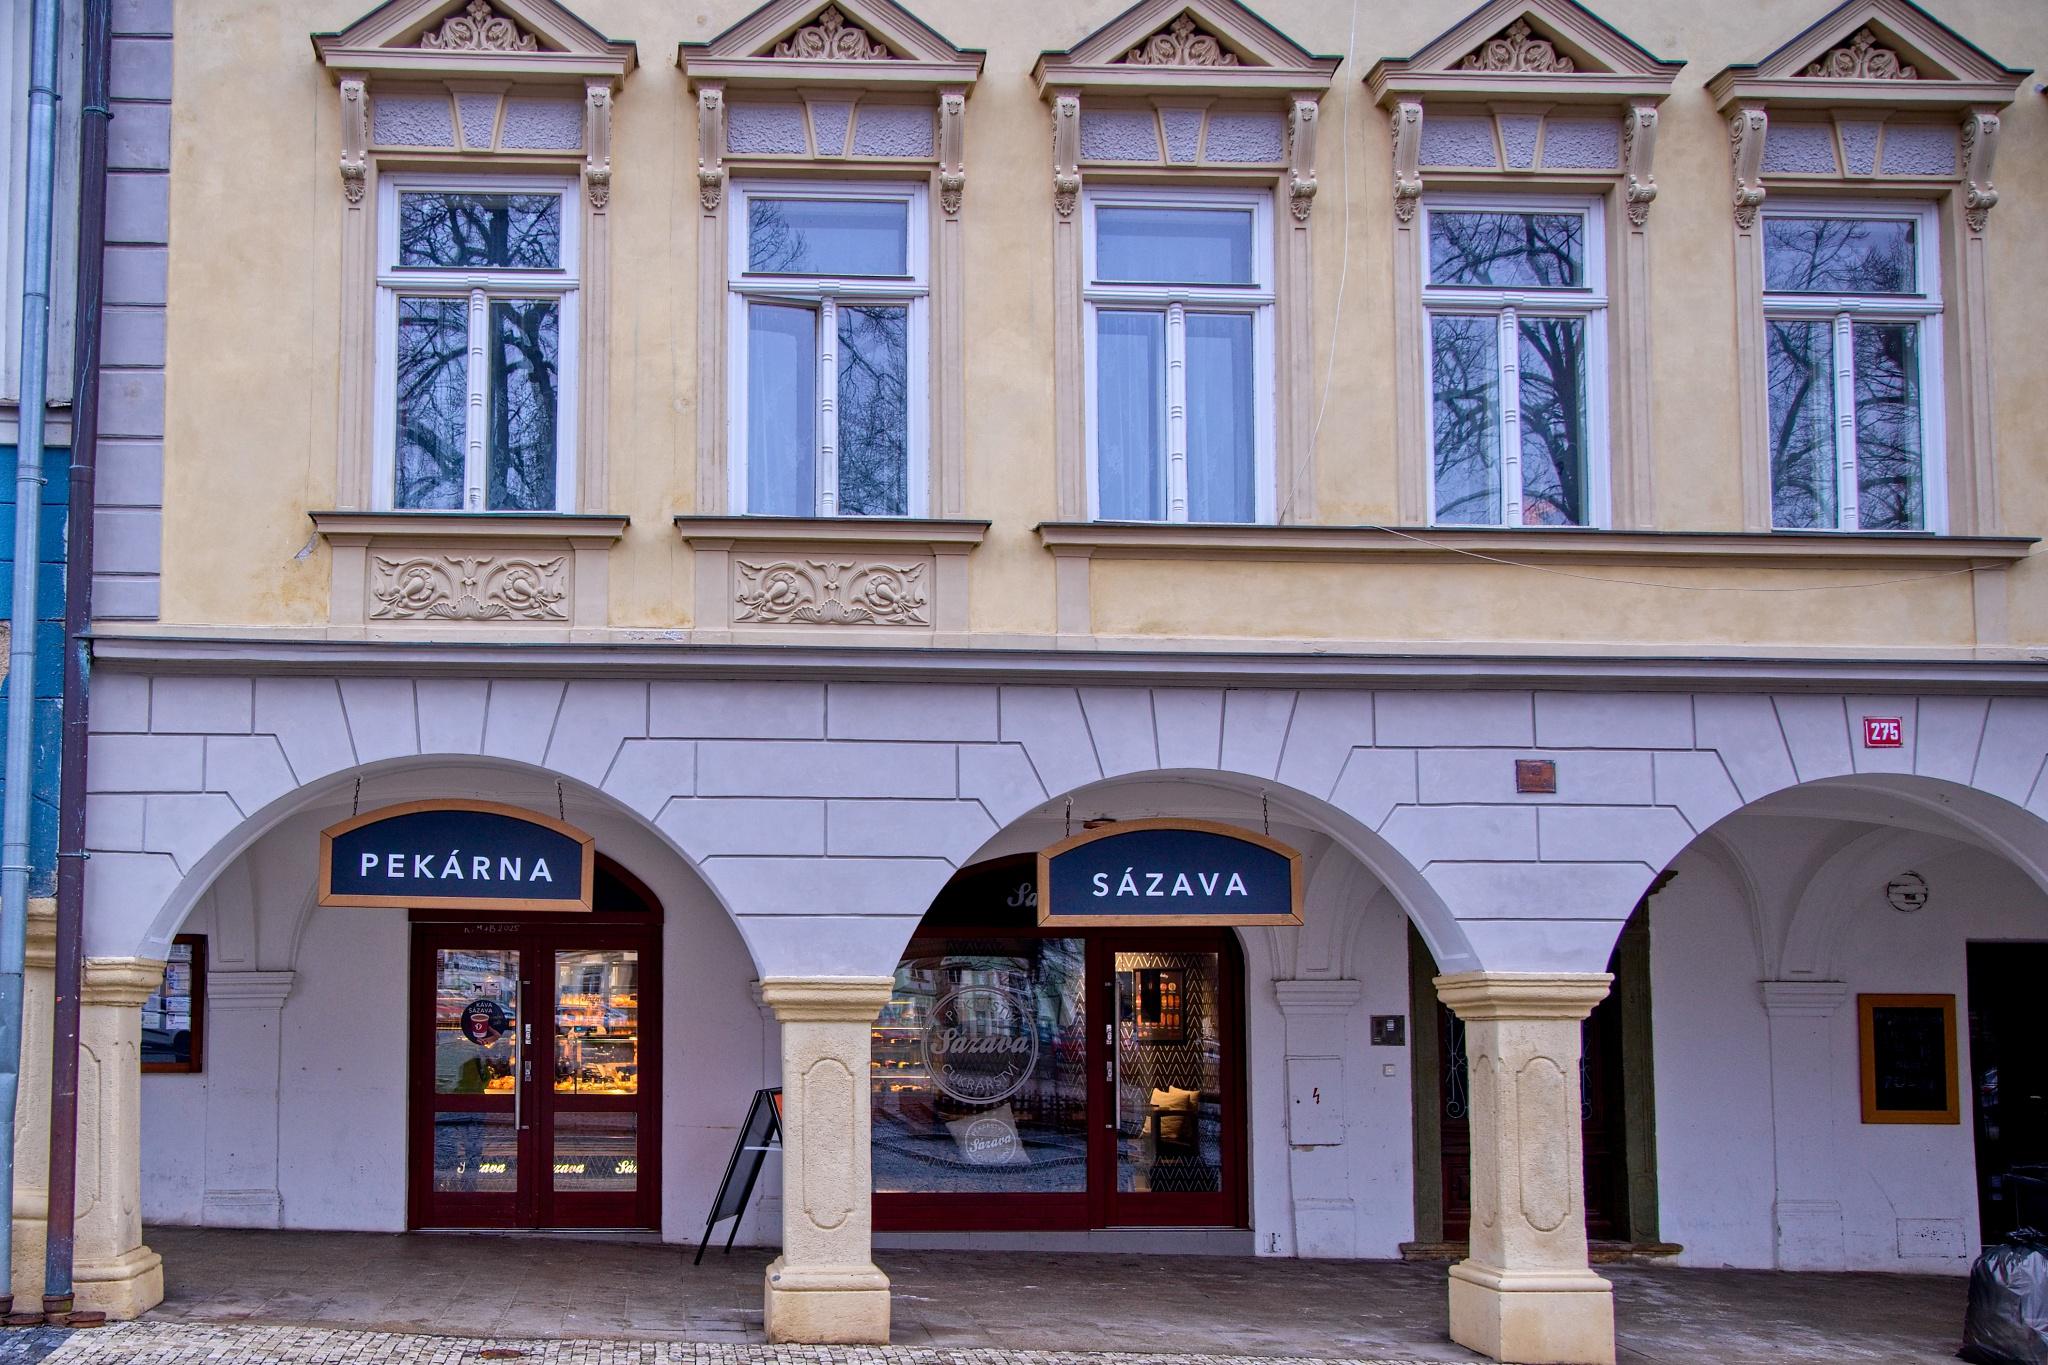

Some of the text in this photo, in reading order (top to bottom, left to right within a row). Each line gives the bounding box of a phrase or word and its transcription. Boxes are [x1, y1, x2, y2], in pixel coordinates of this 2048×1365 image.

[1871, 722, 1899, 741] 275
[360, 849, 553, 882] PEKÁRNA
[1092, 866, 1248, 897] SÁZAVA
[930, 1027, 1029, 1054] Sázava
